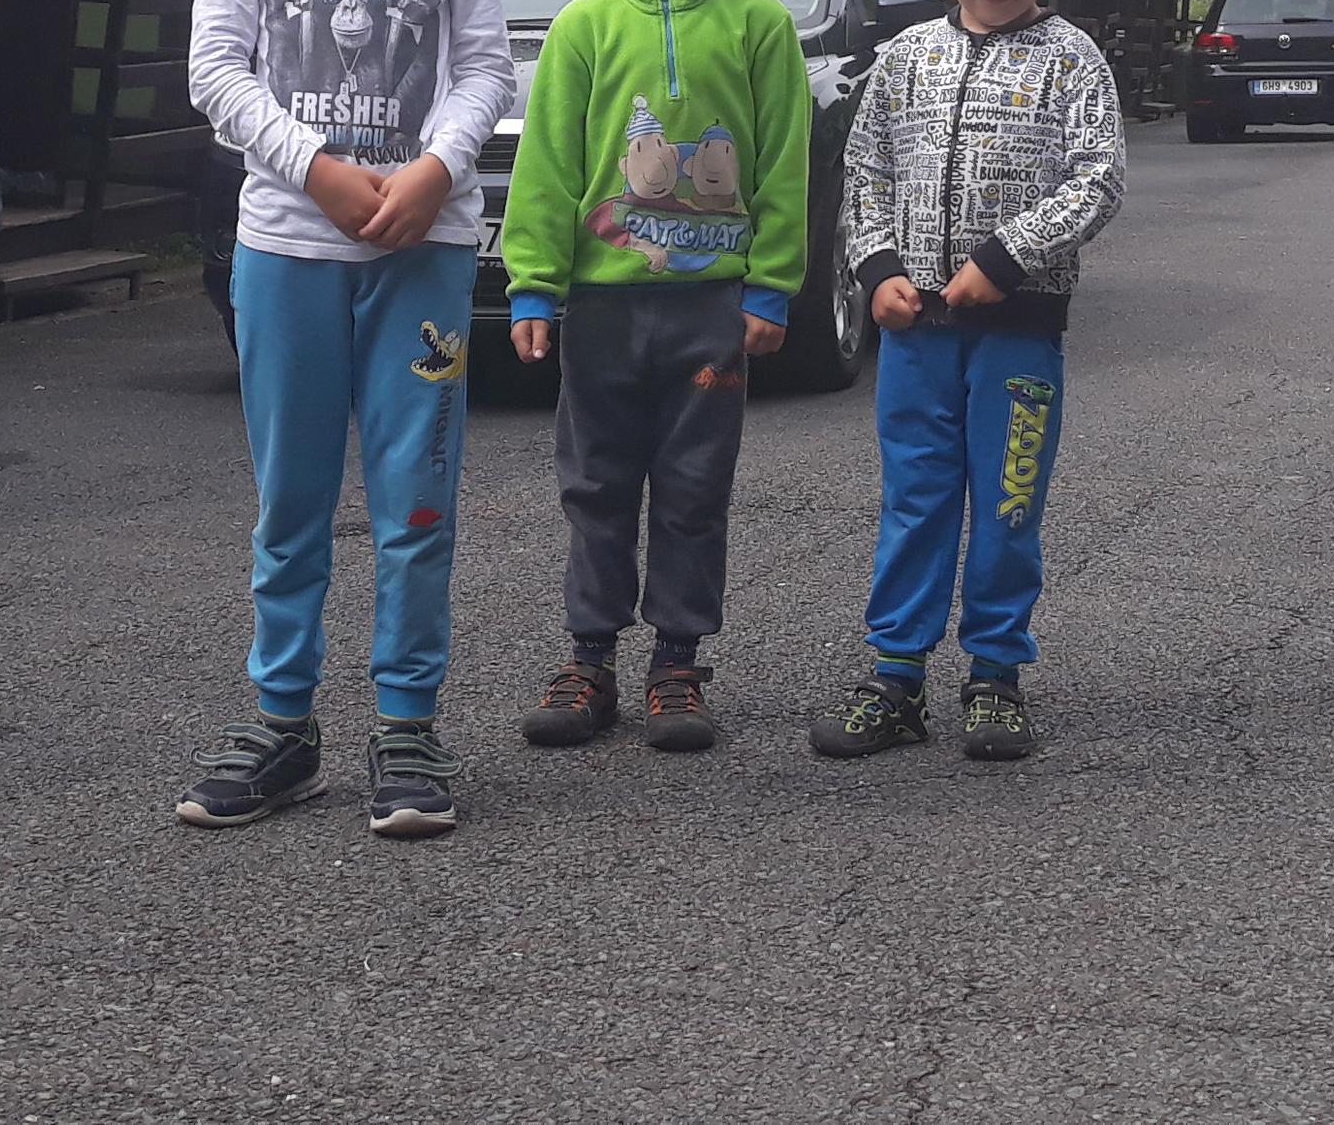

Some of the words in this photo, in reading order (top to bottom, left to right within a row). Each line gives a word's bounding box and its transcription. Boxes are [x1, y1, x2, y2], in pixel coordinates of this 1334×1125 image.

[1288, 81, 1313, 91] 4903
[290, 91, 401, 128] FRESHER
[307, 124, 347, 144] HAN
[351, 125, 385, 148] YOU
[979, 166, 1036, 183] BLUMOCK!
